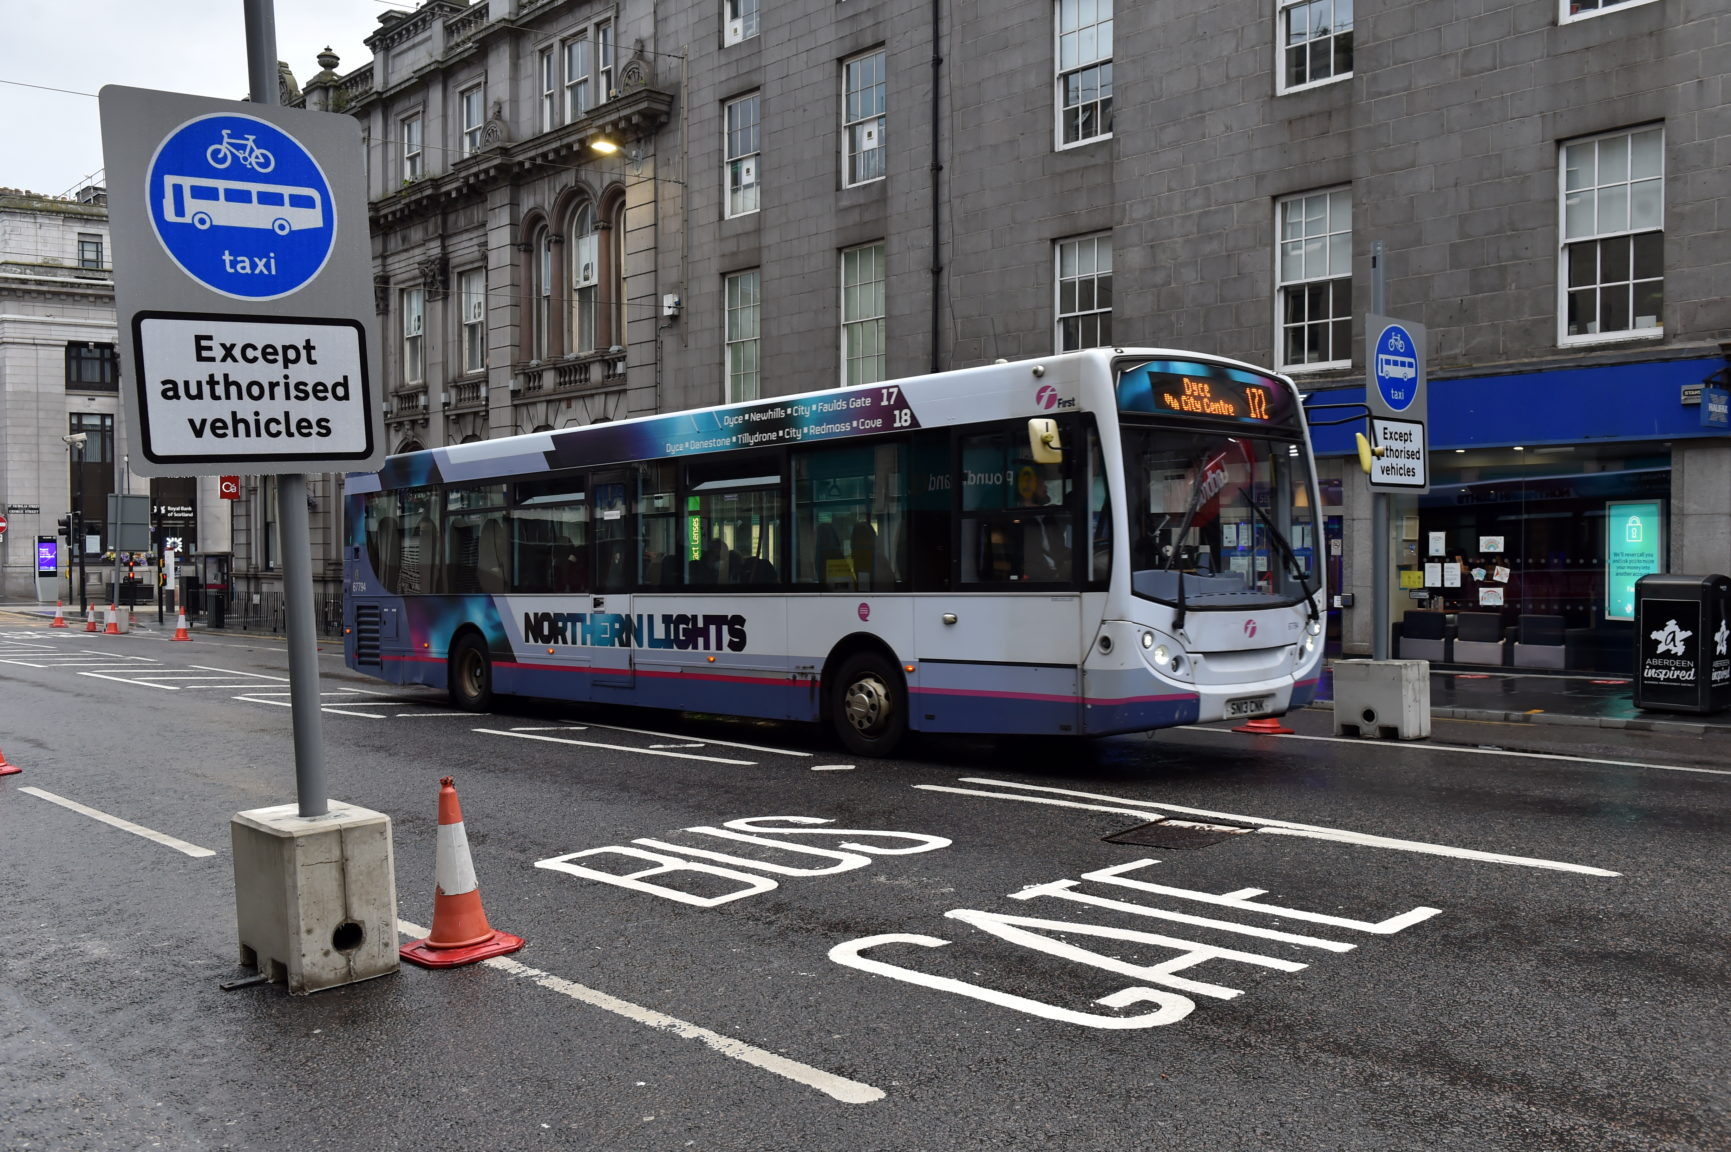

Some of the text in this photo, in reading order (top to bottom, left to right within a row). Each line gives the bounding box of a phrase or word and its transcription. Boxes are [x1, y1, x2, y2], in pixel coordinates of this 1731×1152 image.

[222, 250, 277, 276] taxi
[194, 334, 318, 369] Except
[160, 373, 351, 402] authorised
[1183, 377, 1211, 397] Dyce
[1391, 388, 1405, 400] taxi
[723, 387, 899, 427] Dyce Newhills City Faulds Gate 17
[1057, 397, 1076, 408] First
[1181, 395, 1202, 413] City
[1202, 398, 1235, 416] Centre
[188, 411, 333, 439] vehicles
[666, 408, 911, 455] Dyce Danestone Tillydrone City Redmoss Cove 18
[1383, 427, 1413, 444] Except
[1380, 445, 1421, 461] thorised
[1380, 464, 1416, 478] vehicles
[691, 517, 699, 546] Lenses
[524, 612, 747, 653] NORTHERN LIGHTS
[1644, 665, 1696, 681] inspired
[1646, 658, 1694, 667] ABERDEEN
[535, 814, 953, 908] BUS
[828, 858, 1442, 1031] GATE
